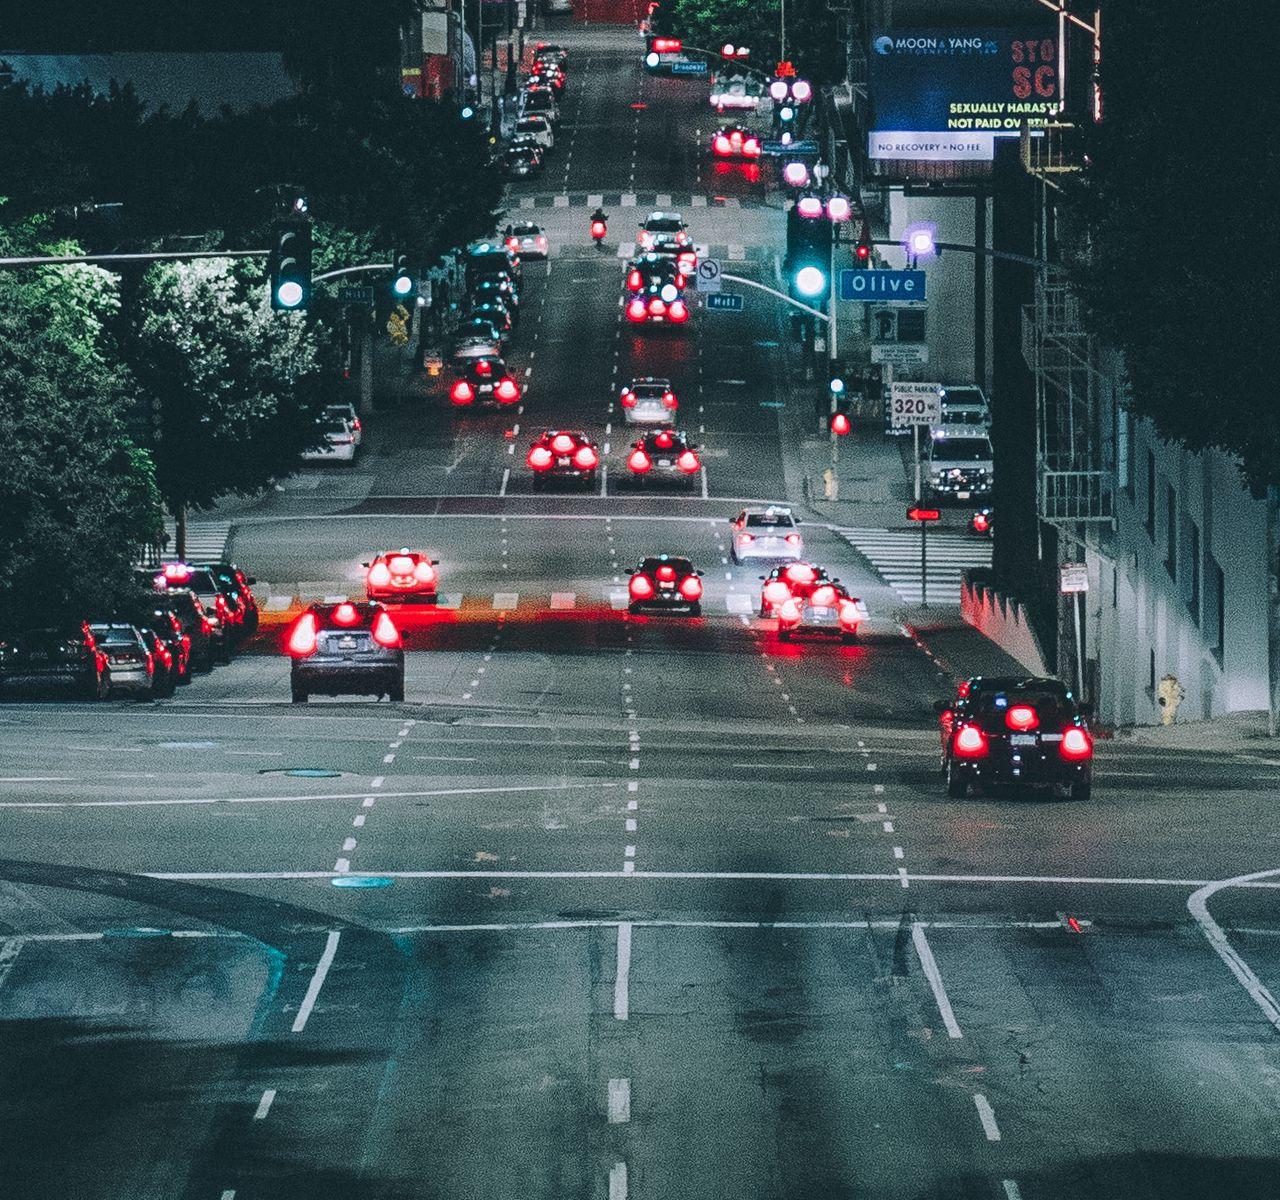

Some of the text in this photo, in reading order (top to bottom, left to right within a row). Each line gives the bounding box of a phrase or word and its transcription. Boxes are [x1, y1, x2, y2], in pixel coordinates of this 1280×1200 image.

[896, 38, 937, 49] MOON
[948, 38, 982, 49] YANG
[949, 102, 1005, 113] SEXUALLY
[948, 118, 973, 129] NOT
[975, 118, 1002, 129] PAID
[895, 143, 940, 151] RECOVERY
[852, 275, 915, 292] Olive
[714, 297, 735, 306] Hill
[895, 399, 926, 414] 320
